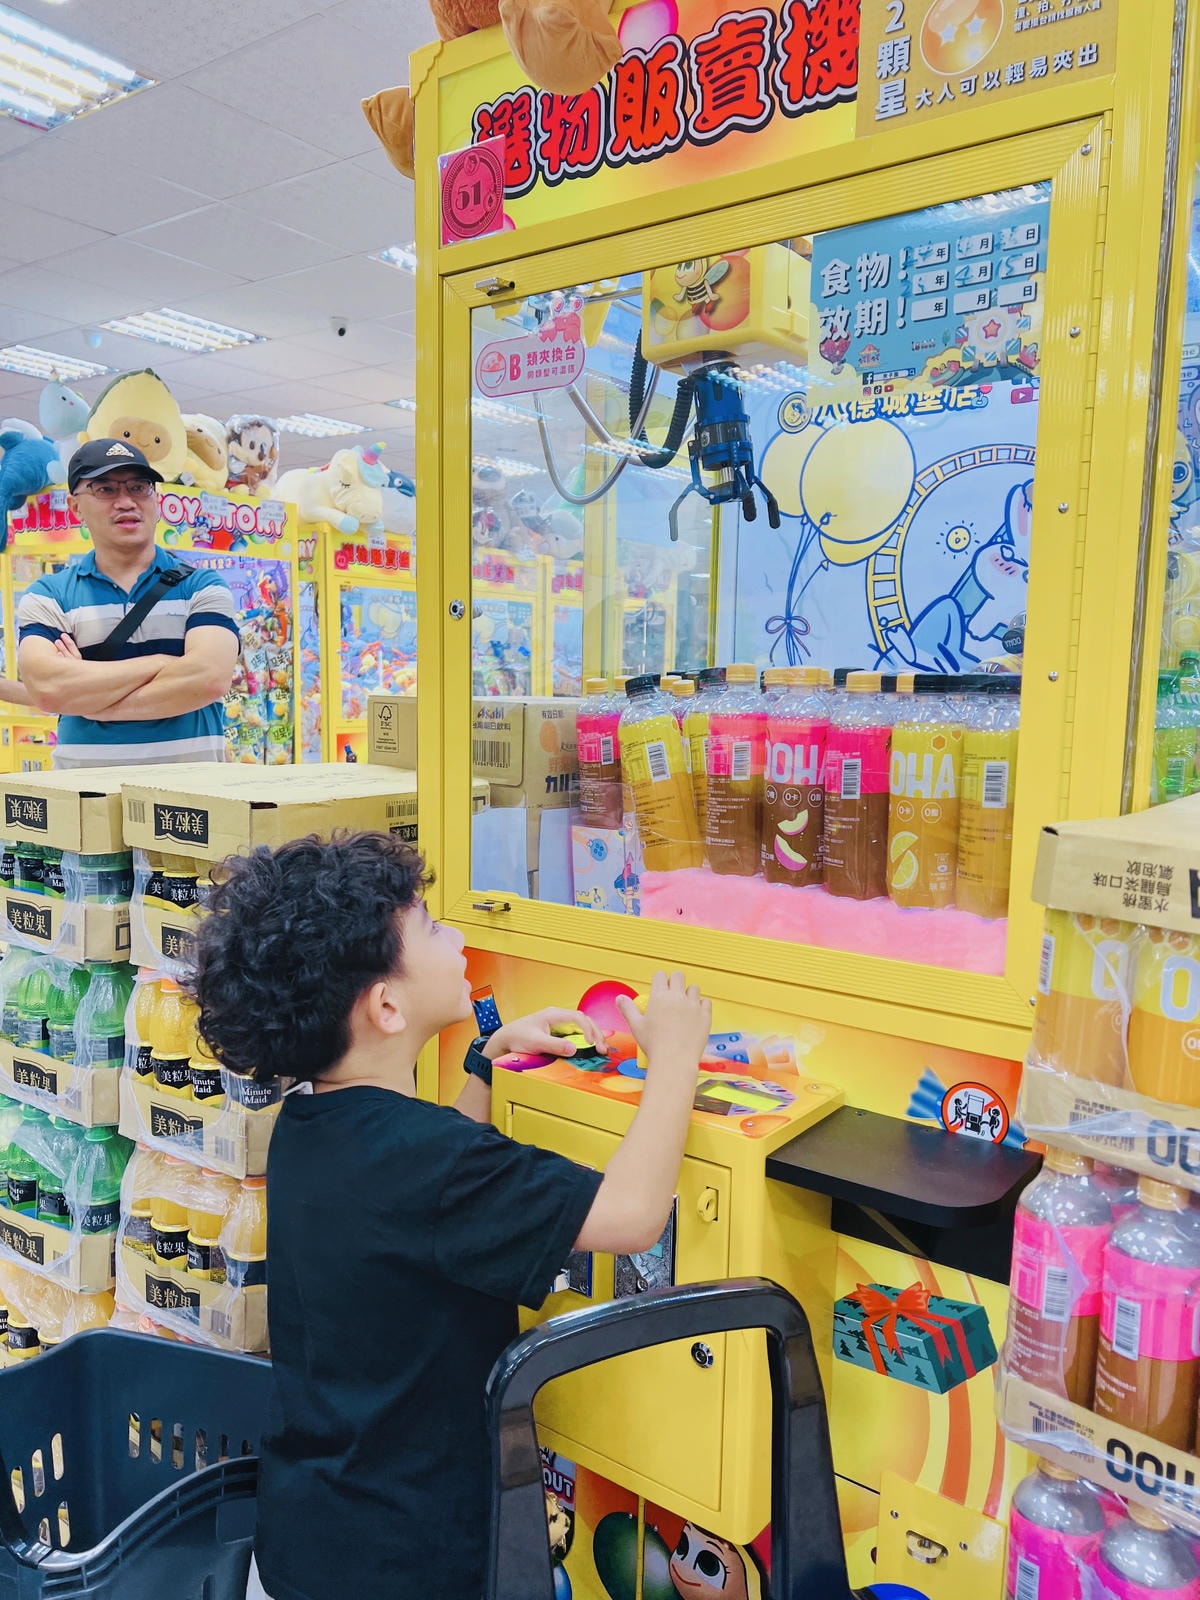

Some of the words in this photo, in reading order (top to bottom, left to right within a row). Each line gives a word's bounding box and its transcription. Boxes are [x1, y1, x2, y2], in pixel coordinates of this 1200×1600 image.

[914, 43, 1099, 110] 大人可以輕易夾出
[456, 180, 481, 211] 51
[936, 247, 946, 259] 年
[979, 237, 990, 250] 月
[1026, 228, 1036, 241] 日
[935, 274, 945, 286] 年
[978, 265, 988, 278] 月
[1024, 257, 1034, 269] 日
[934, 302, 944, 313] 年
[977, 293, 987, 305] 月
[1023, 285, 1033, 297] 日
[509, 353, 521, 381] B
[159, 493, 202, 527] OY
[477, 706, 505, 720] Asahi
[159, 809, 205, 836] 美粒果
[1126, 860, 1175, 881] 氣泡飲
[1091, 872, 1173, 898] 烏龍茶口味
[1122, 893, 1170, 913] 水蜜桃
[11, 908, 46, 934] 美粒果
